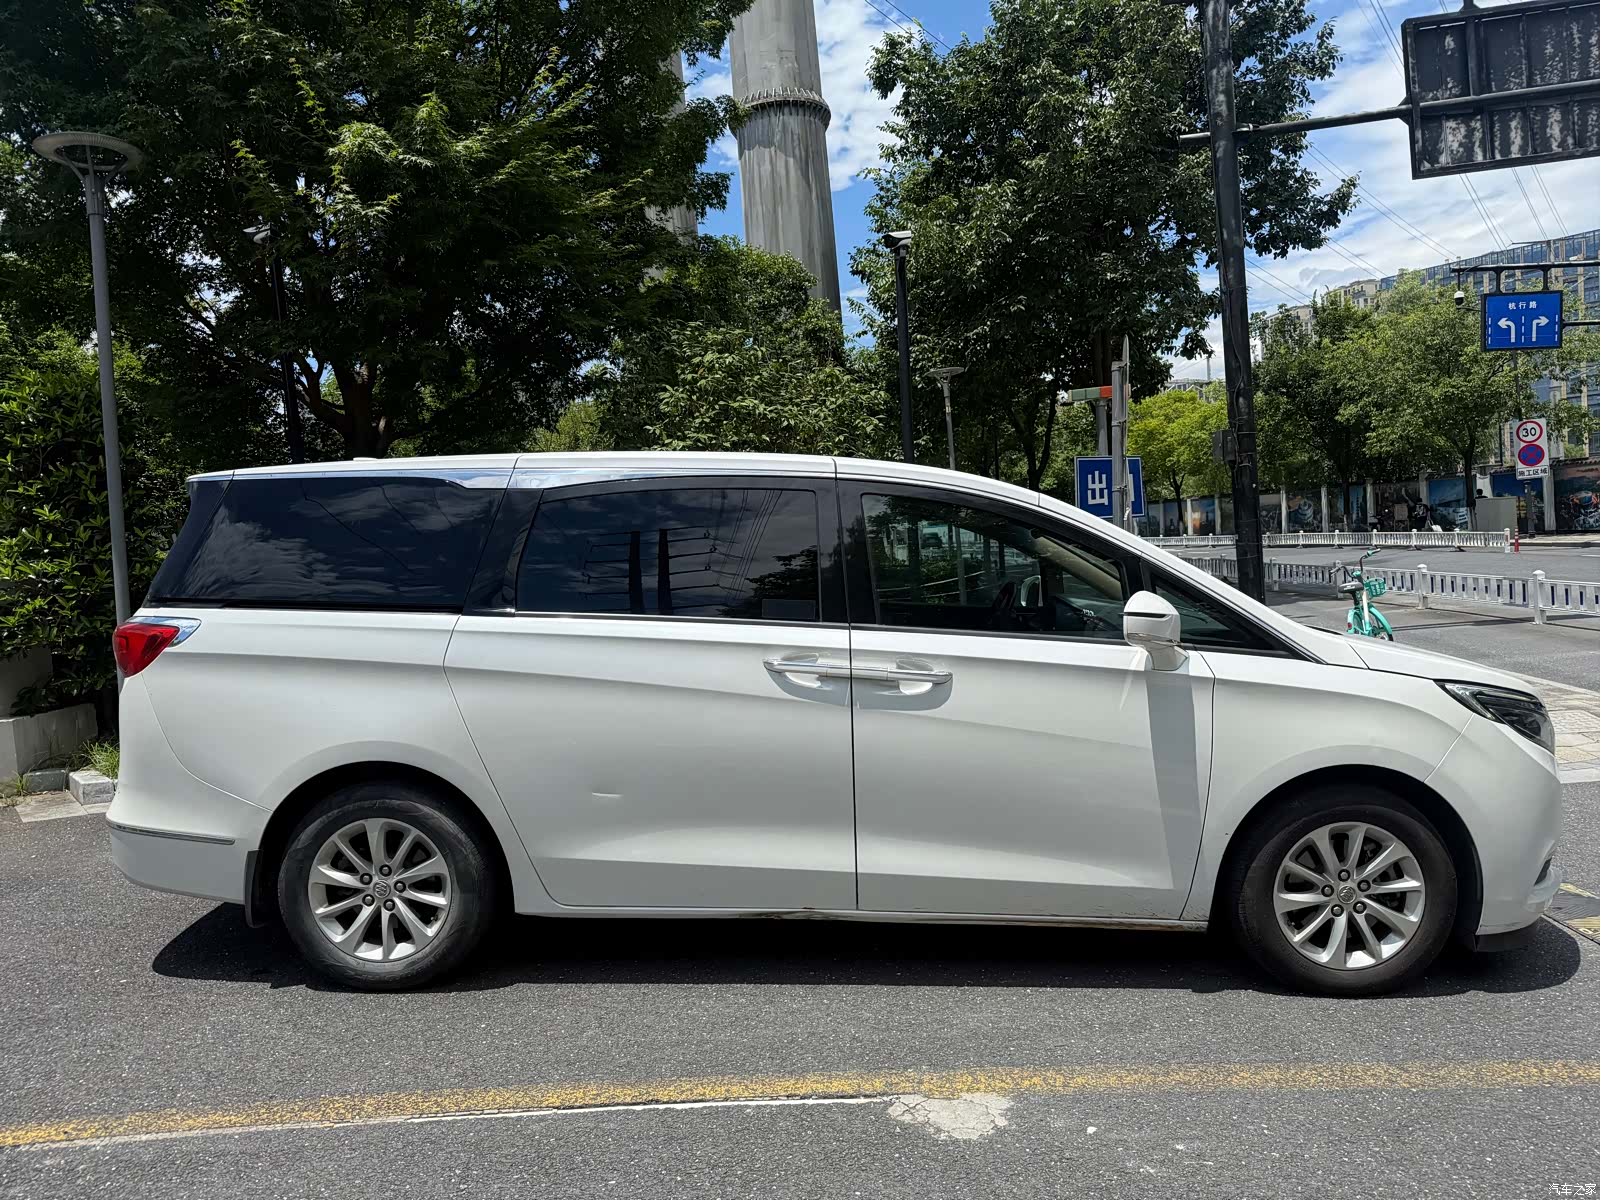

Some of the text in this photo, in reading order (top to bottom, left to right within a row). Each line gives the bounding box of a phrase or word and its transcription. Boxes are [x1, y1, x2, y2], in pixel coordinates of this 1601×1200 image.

[1508, 301, 1537, 310] 杭行路
[1522, 427, 1537, 437] 30
